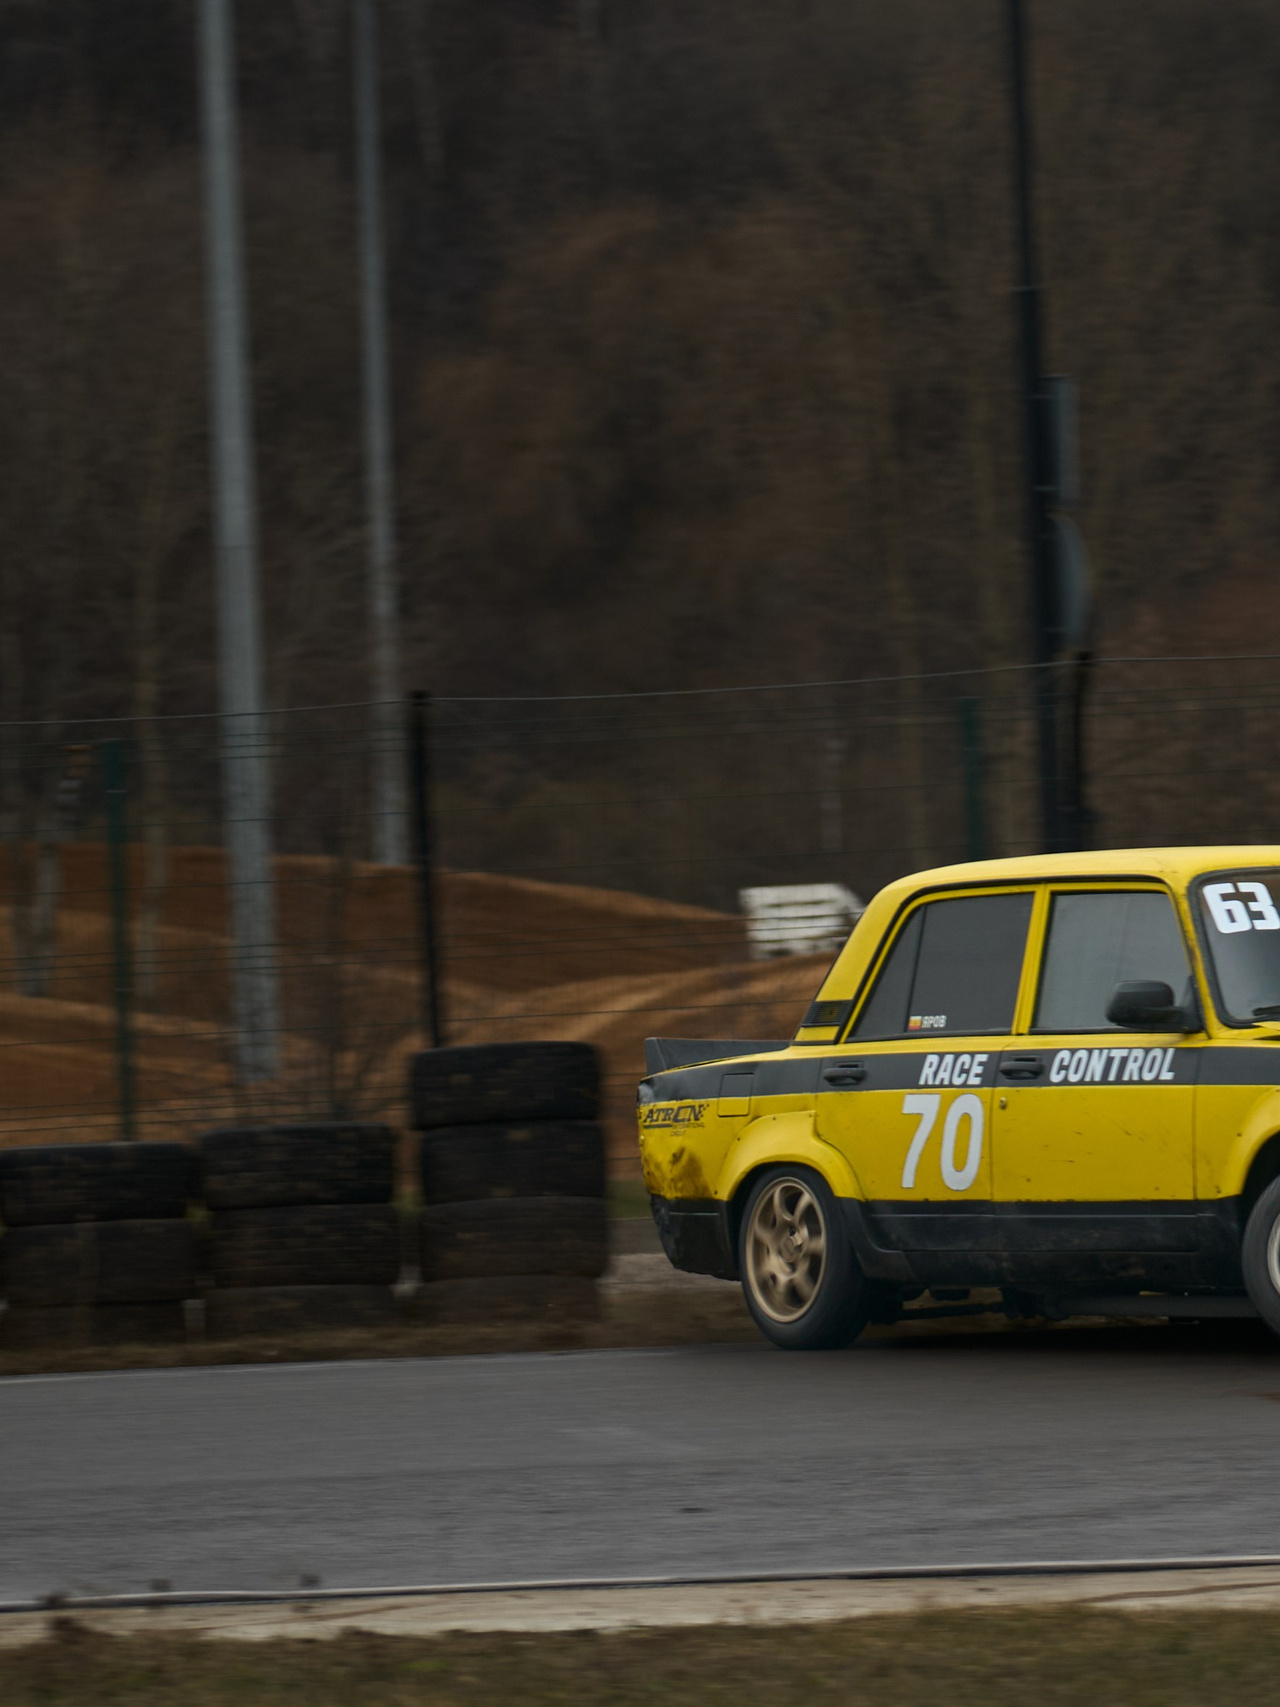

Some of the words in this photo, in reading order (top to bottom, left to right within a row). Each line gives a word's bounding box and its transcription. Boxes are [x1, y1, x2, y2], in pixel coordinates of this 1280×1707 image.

[919, 1053, 986, 1086] RACE
[1049, 1047, 1176, 1084] CONTROL
[902, 1093, 985, 1191] 70
